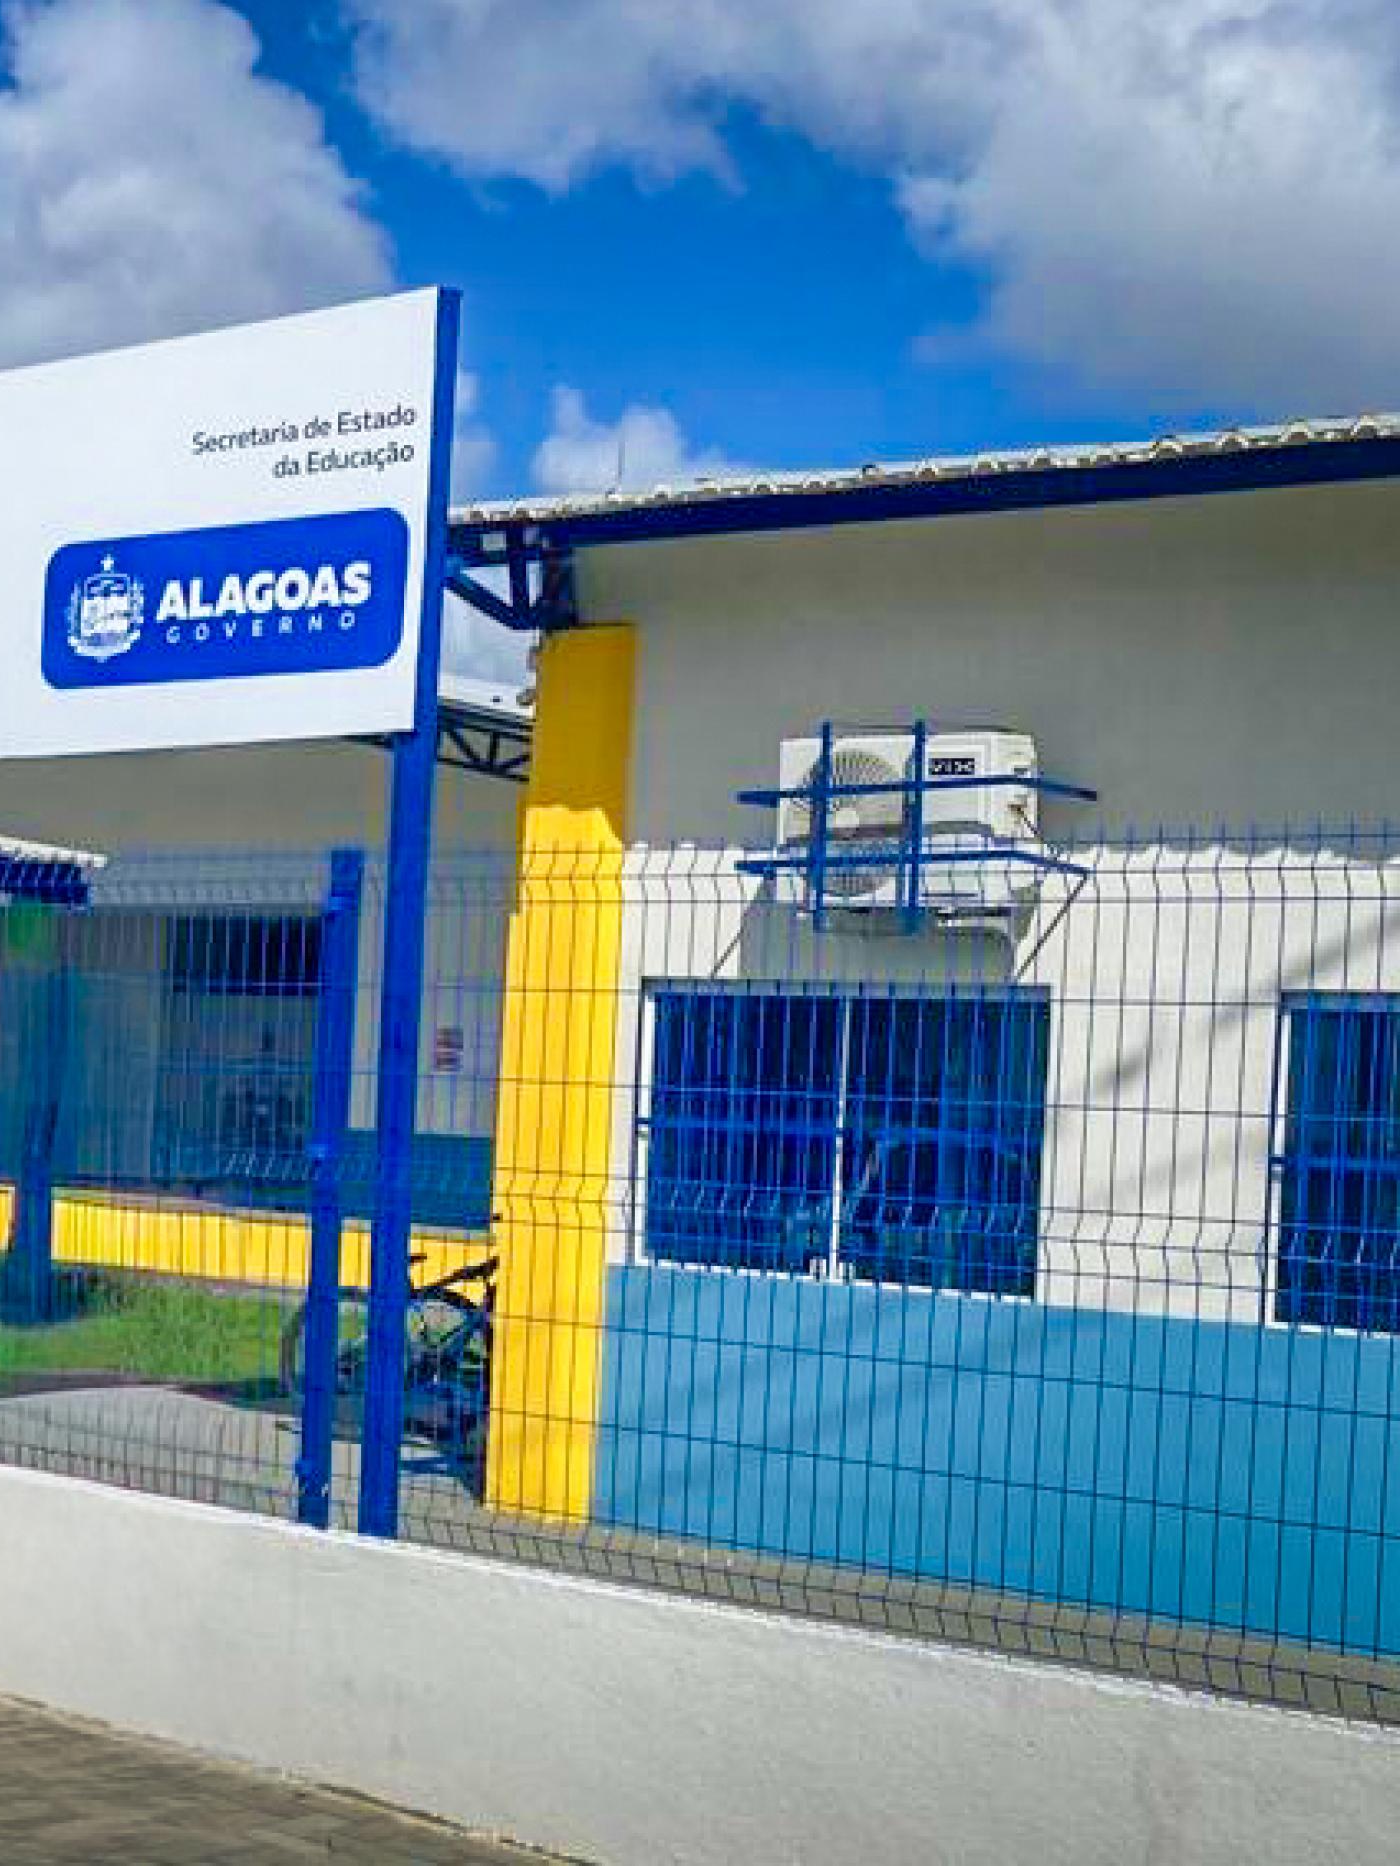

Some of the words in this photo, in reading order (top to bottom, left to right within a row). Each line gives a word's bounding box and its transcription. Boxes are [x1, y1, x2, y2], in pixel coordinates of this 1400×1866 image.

[192, 423, 299, 455] Secretaria
[303, 416, 332, 440] de
[337, 404, 416, 435] Estado
[274, 456, 299, 478] da
[306, 442, 416, 477] Educação
[156, 560, 372, 621] ALAGOAS
[166, 611, 355, 643] GOVERNO
